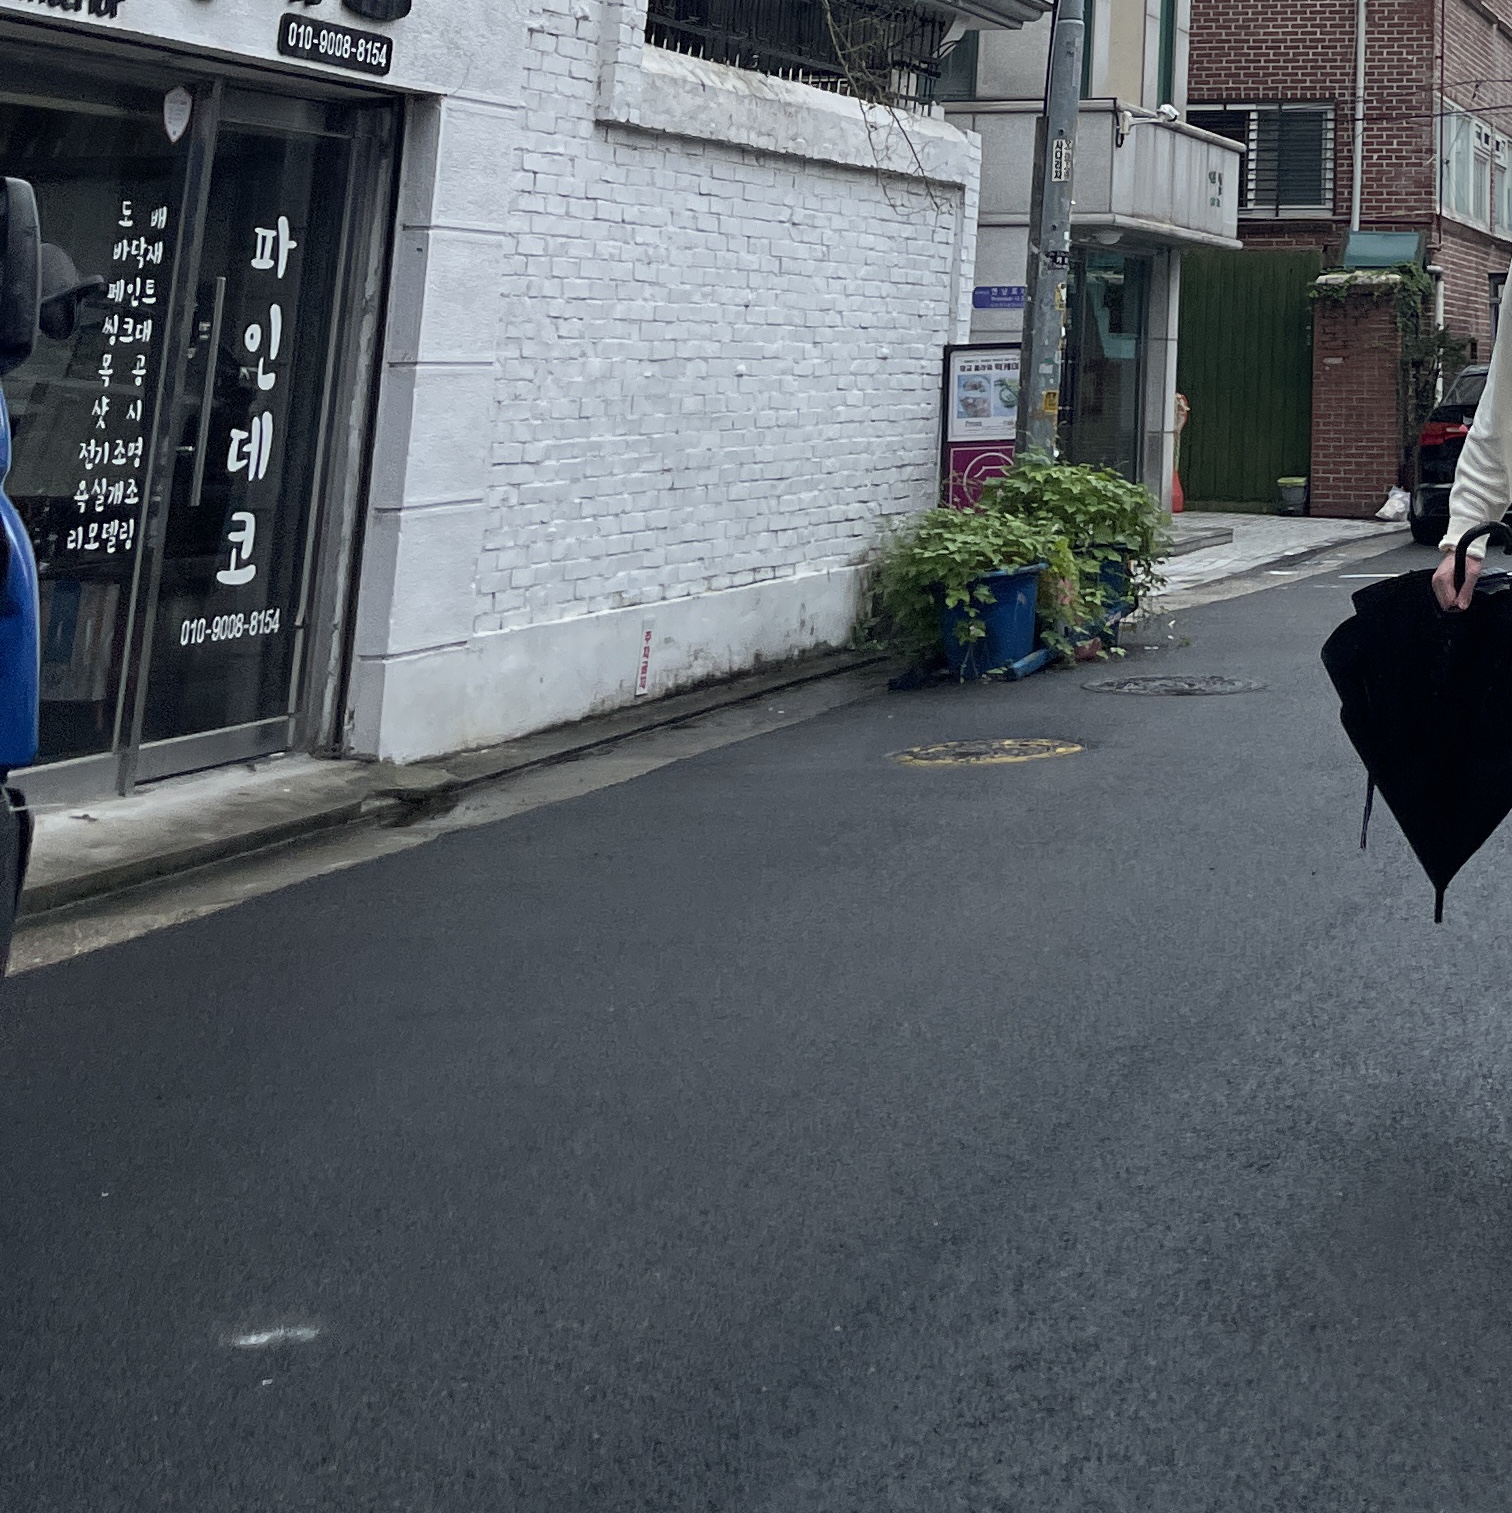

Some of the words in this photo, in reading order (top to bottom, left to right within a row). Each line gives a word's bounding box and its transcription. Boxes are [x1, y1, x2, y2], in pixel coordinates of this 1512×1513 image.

[287, 22, 388, 67] 010-9008-8154
[112, 236, 164, 269] 바닥재
[106, 276, 157, 307] 페인트
[101, 314, 153, 346] 씽크대
[78, 436, 143, 470] 전기조명
[73, 477, 139, 514] 욕실개조
[66, 518, 135, 554] 리모델링
[180, 608, 280, 646] 010-9008-8154
